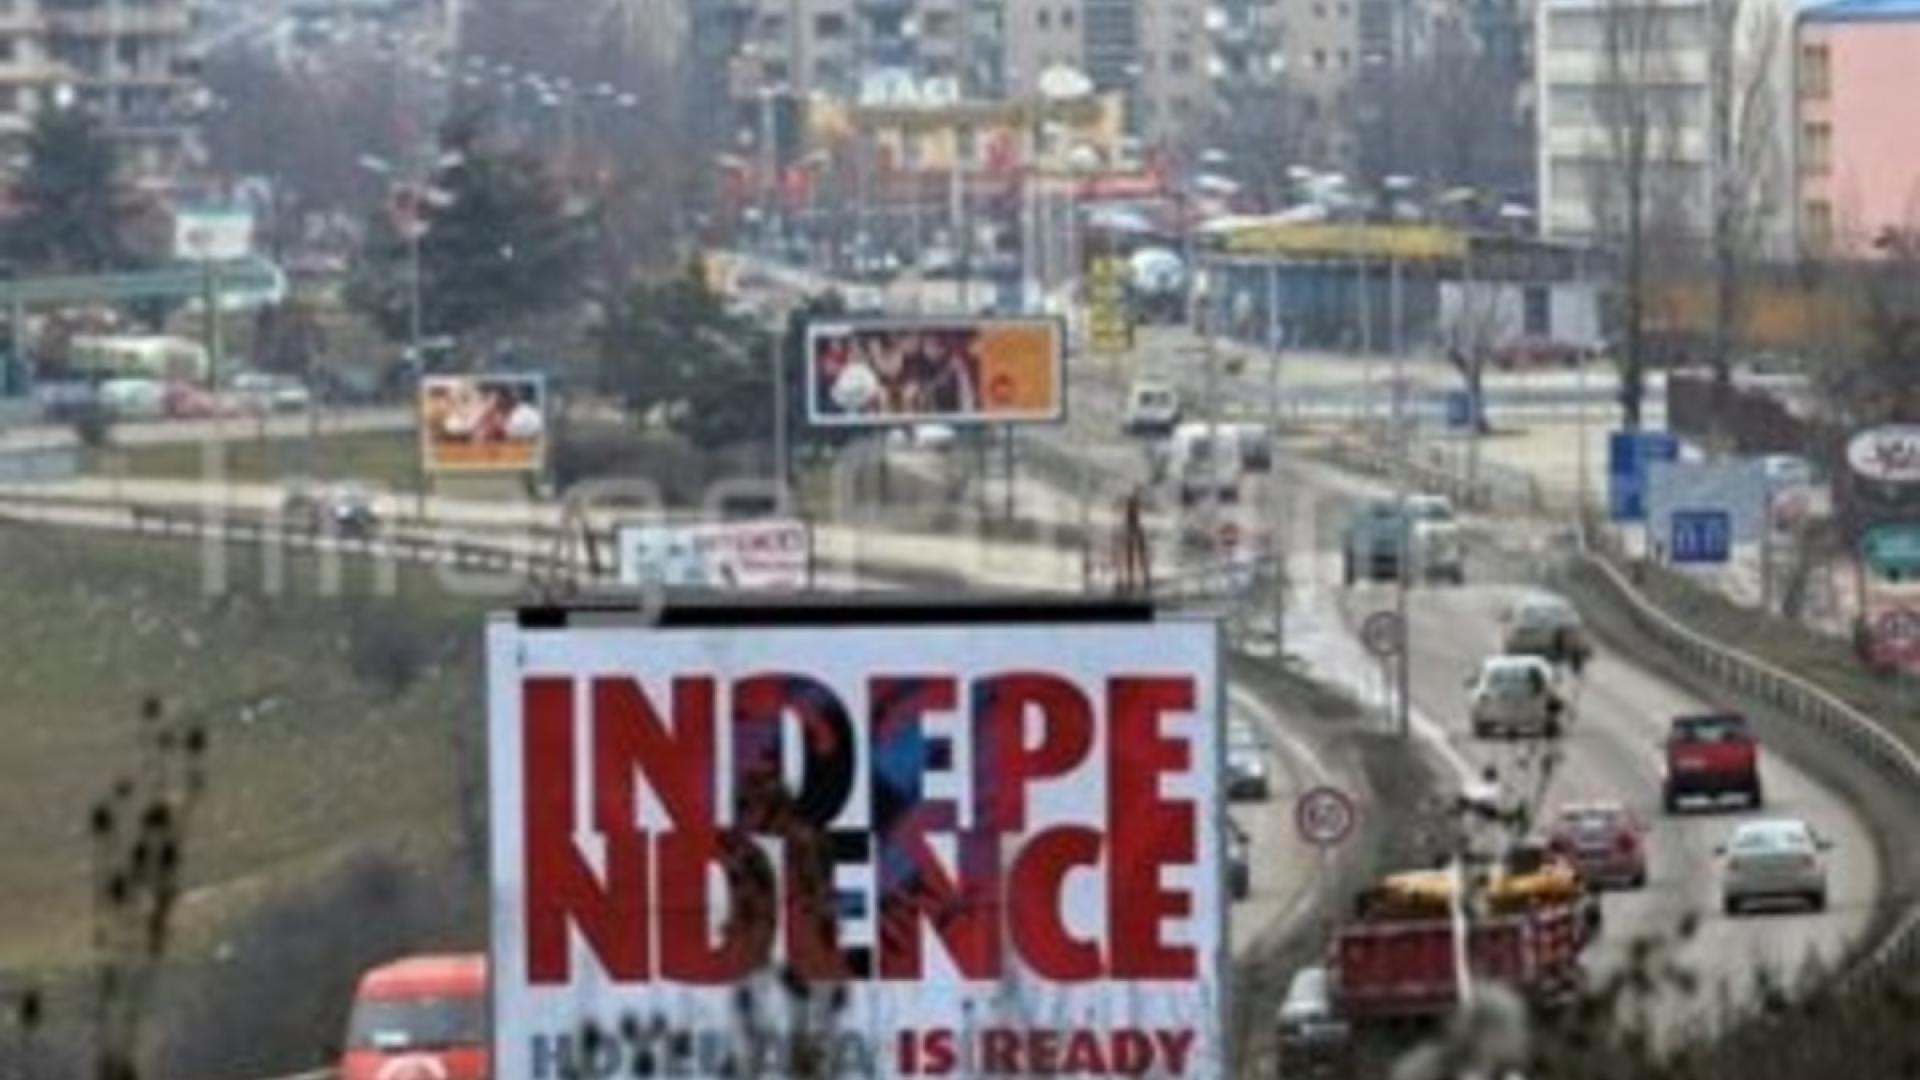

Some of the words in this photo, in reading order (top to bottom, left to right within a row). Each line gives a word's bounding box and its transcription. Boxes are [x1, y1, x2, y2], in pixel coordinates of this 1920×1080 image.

[521, 672, 1197, 832] INDEPE
[525, 826, 1199, 985] NDENCE
[748, 1033, 876, 1080] AA
[897, 1029, 956, 1076] IS
[979, 1028, 1195, 1077] READY
